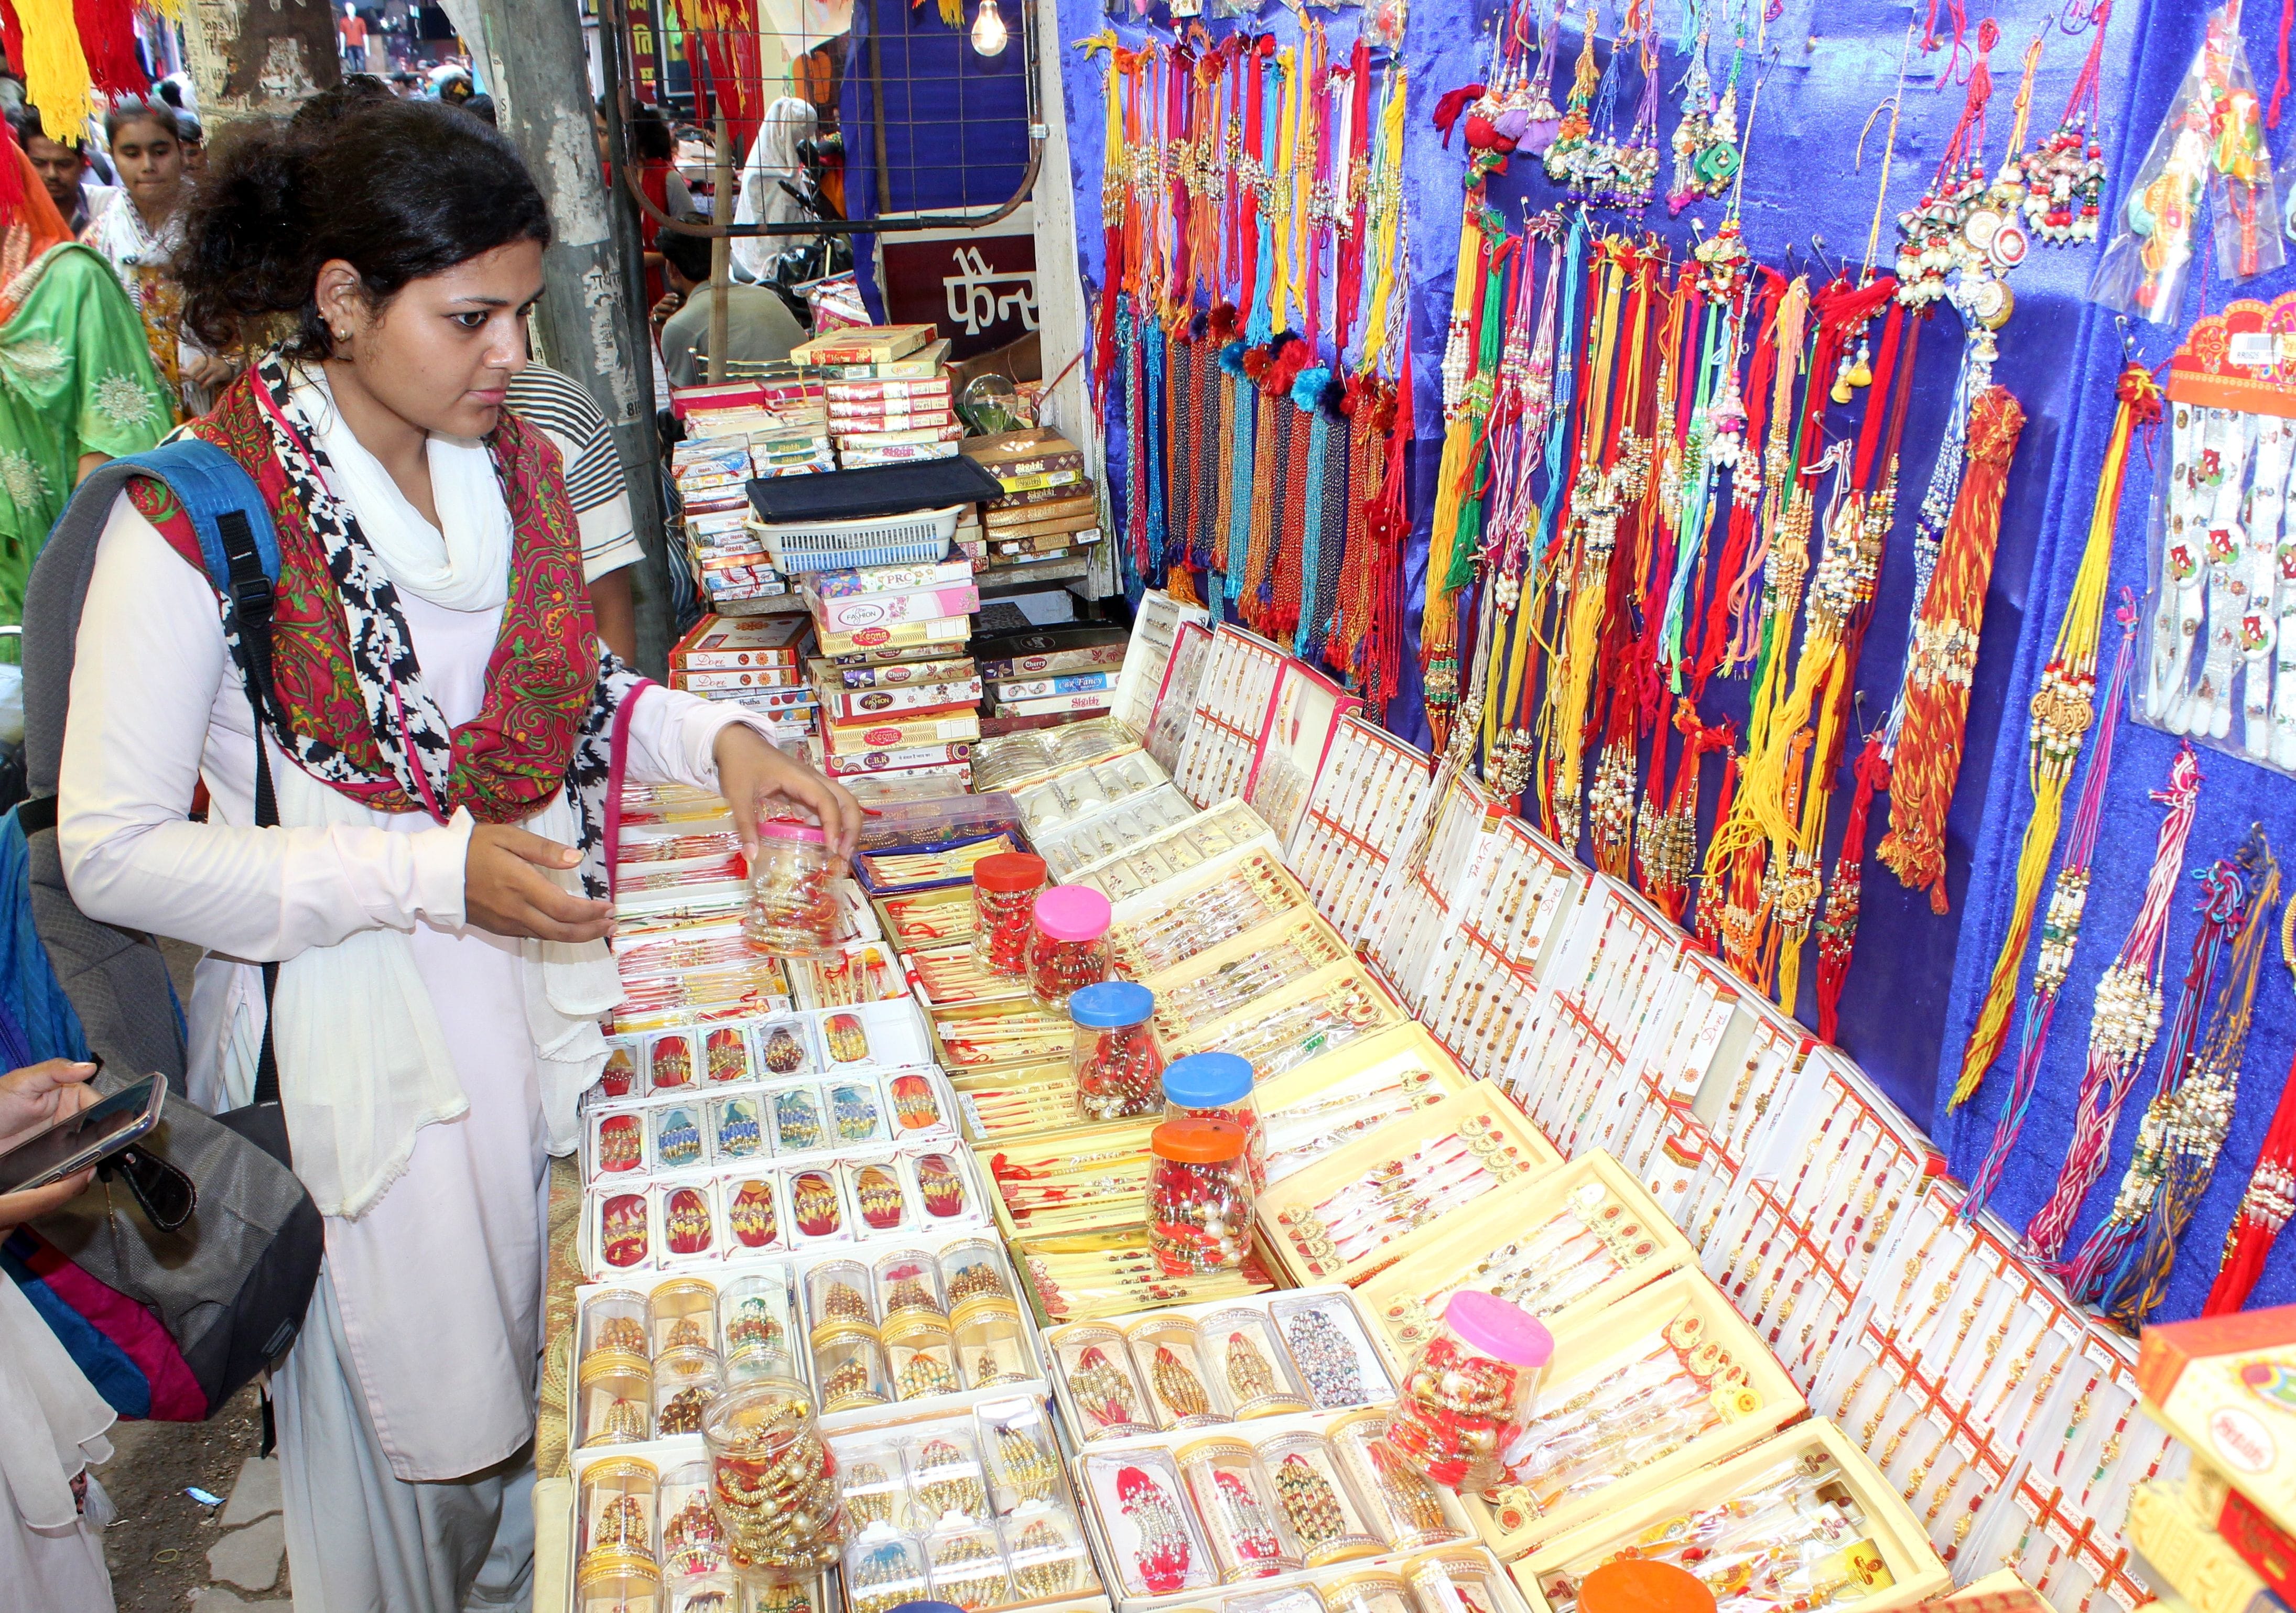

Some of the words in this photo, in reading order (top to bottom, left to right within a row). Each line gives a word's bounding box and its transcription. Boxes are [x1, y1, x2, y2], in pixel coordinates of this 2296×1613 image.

[1015, 460, 1045, 474] Shubh
[886, 572, 913, 584] PRC
[847, 611, 876, 625] FASHION
[695, 653, 724, 666] Dori
[696, 675, 725, 686] Dori
[1077, 677, 1102, 688] Fancy
[865, 697, 890, 710] FASHION
[1071, 696, 1100, 708] Shubh
[1701, 1012, 1725, 1047] Dori
[2009, 1268, 2025, 1287] RAKHI
[2034, 1293, 2052, 1312] RAKHI
[2061, 1318, 2078, 1337] RAKHI
[2092, 1345, 2112, 1365] RAKHI
[2125, 1567, 2146, 1590] RAKHI
